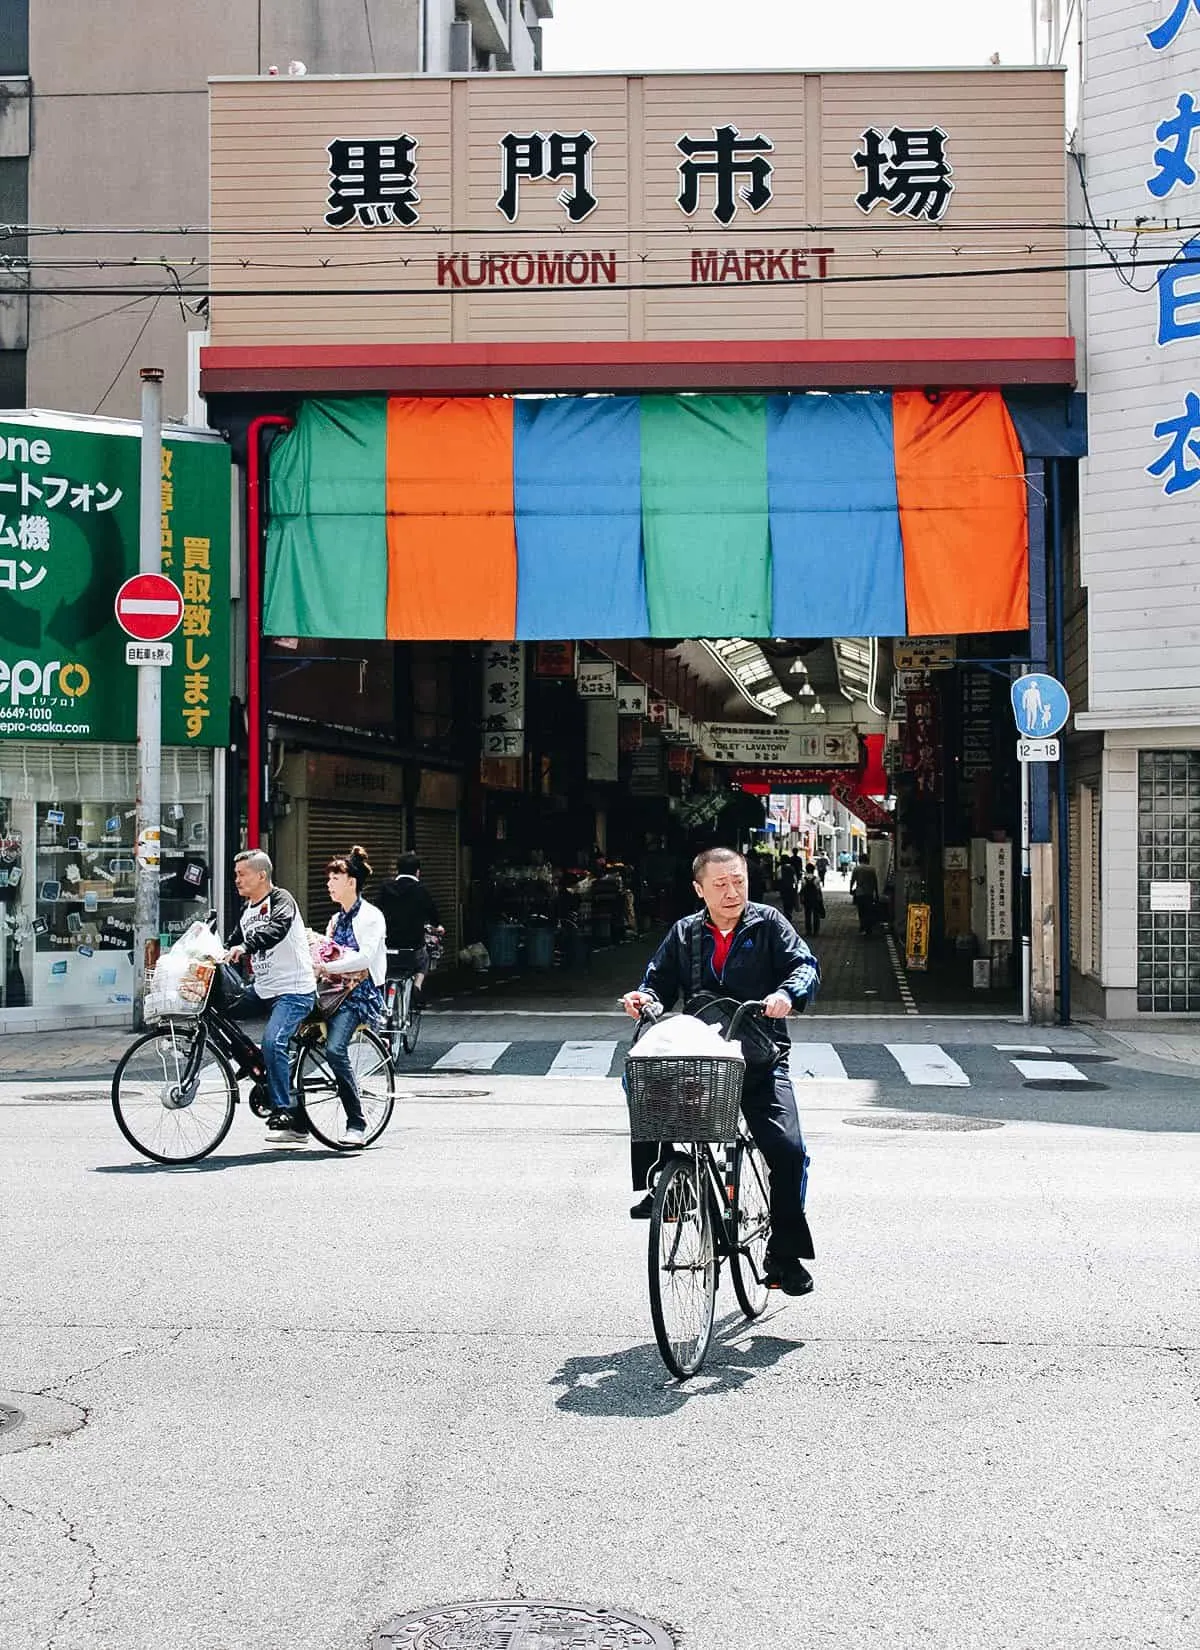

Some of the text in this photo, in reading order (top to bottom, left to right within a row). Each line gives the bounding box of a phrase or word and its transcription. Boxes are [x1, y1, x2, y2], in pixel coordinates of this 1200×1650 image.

[323, 123, 956, 229] 黒門市場
[437, 247, 835, 287] KUROMON MARKET
[182, 536, 210, 737] 買取致します
[489, 735, 517, 753] 2F
[746, 743, 787, 752] LAVATORY
